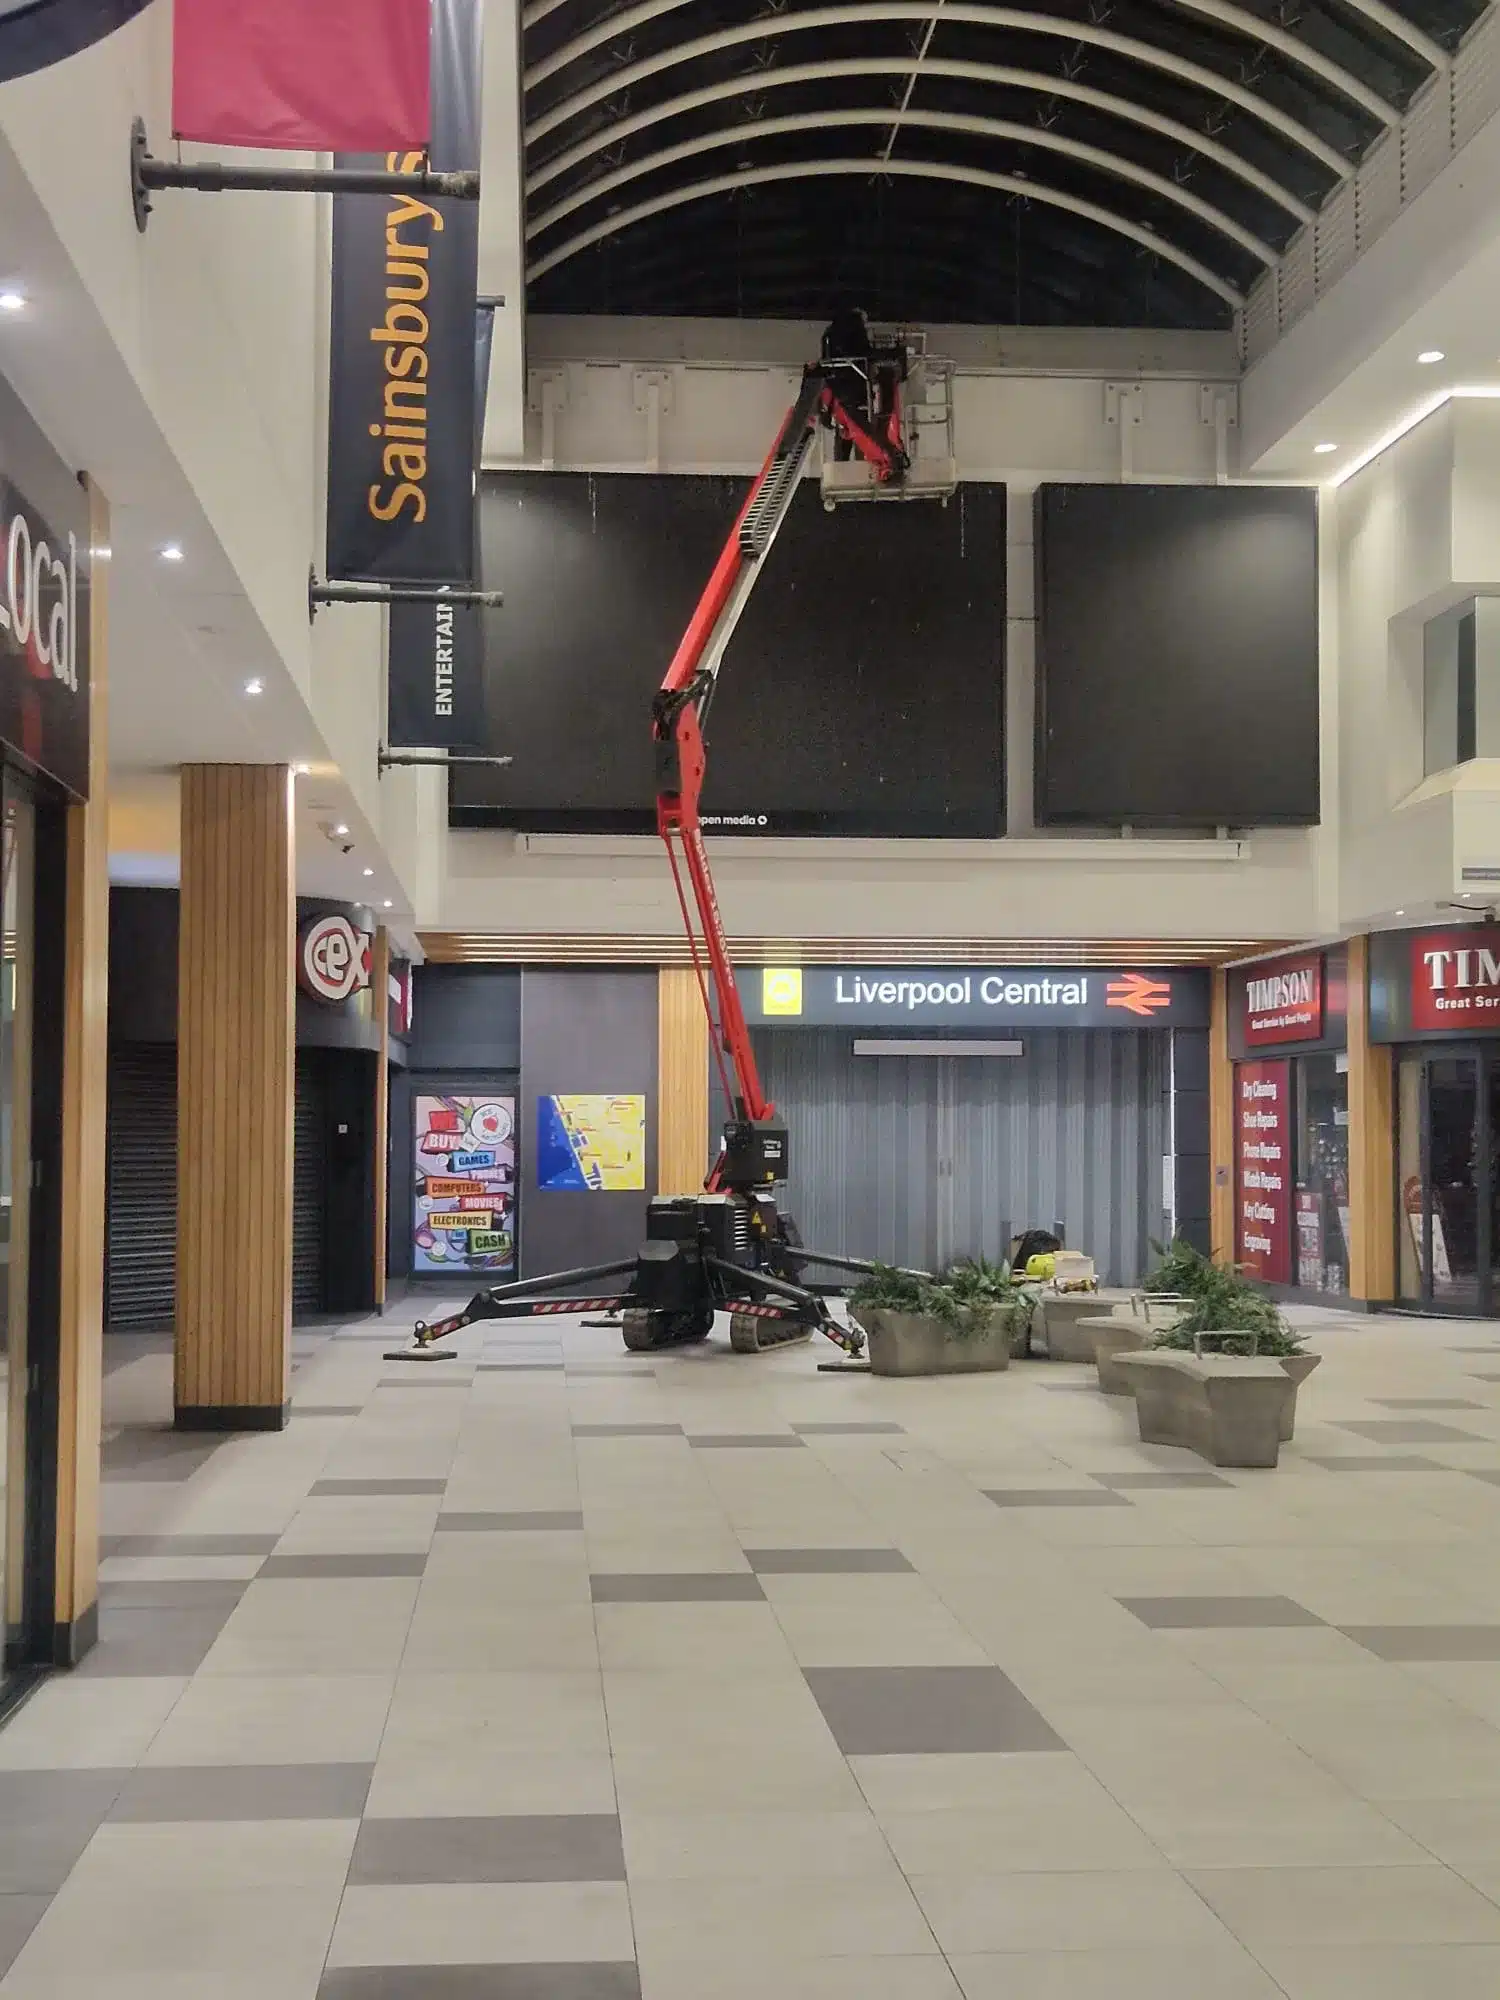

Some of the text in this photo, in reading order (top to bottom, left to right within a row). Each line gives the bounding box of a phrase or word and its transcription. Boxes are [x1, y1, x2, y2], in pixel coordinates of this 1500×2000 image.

[0, 514, 78, 693] ocal
[723, 814, 756, 826] media
[835, 975, 1088, 1010] Liverpool Central
[1246, 969, 1313, 1013] TIMPSON
[1435, 997, 1470, 1010] Great
[429, 1133, 458, 1149] BUY
[458, 1154, 490, 1166] GAMES
[431, 1182, 482, 1194] COMPUTERS
[464, 1197, 500, 1209] MOVIES
[433, 1215, 487, 1227] ELECTRONICS
[475, 1233, 506, 1249] CASH
